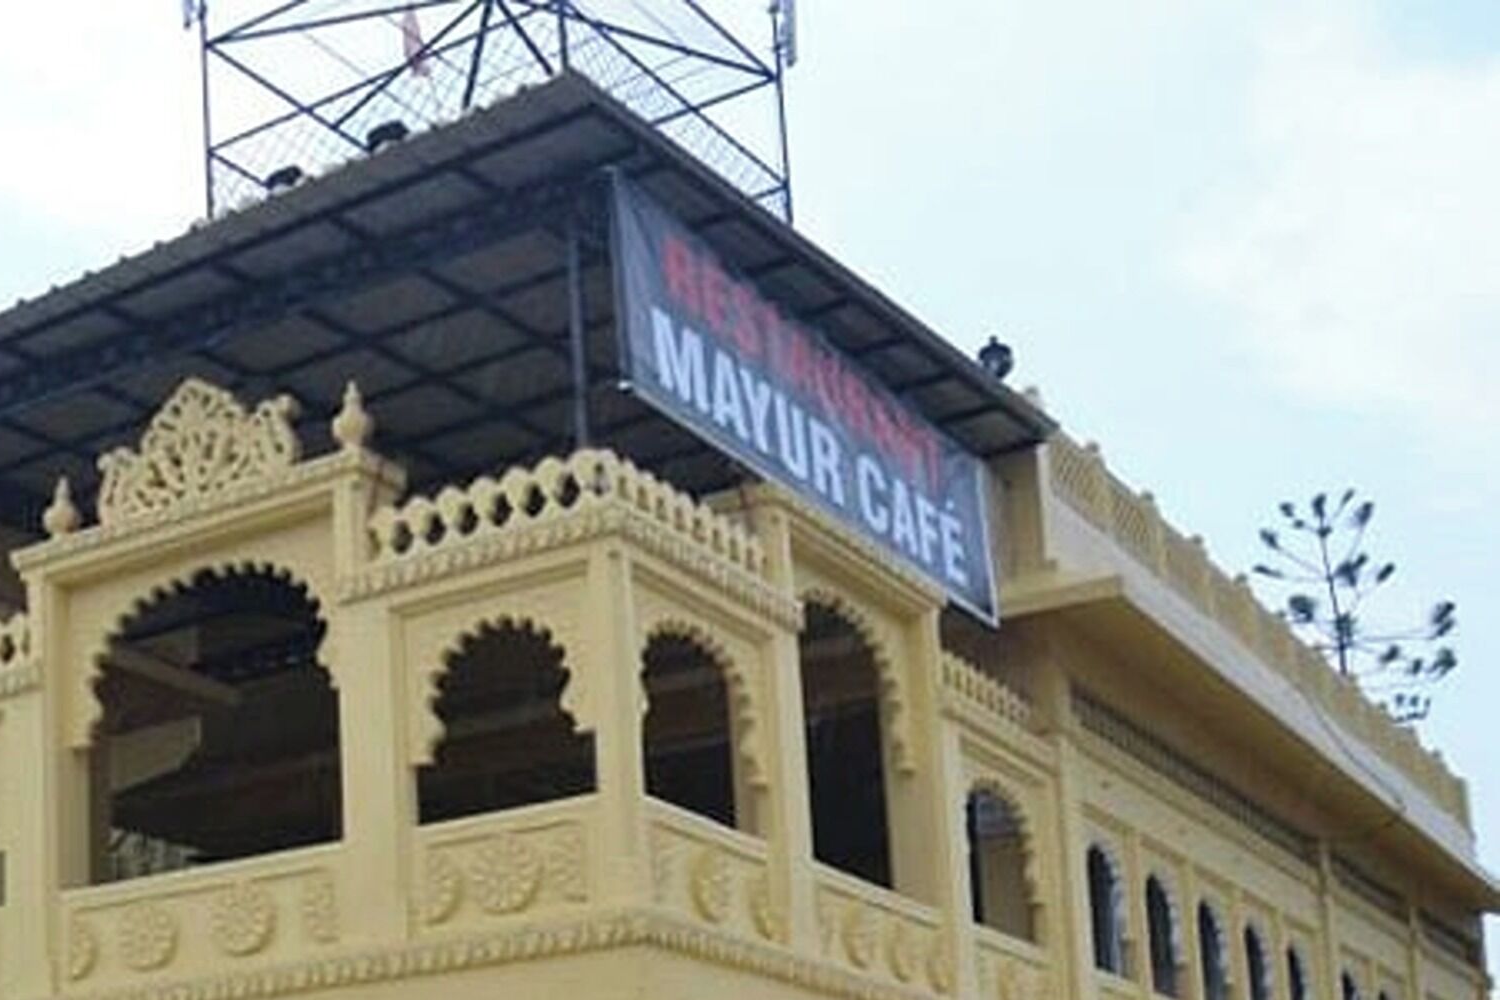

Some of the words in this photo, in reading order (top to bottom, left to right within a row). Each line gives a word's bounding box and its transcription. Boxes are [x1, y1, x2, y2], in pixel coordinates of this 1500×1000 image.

[651, 306, 845, 505] MAYUR
[857, 454, 967, 586] CAFÉ
[661, 234, 943, 496] RESTAURANT
